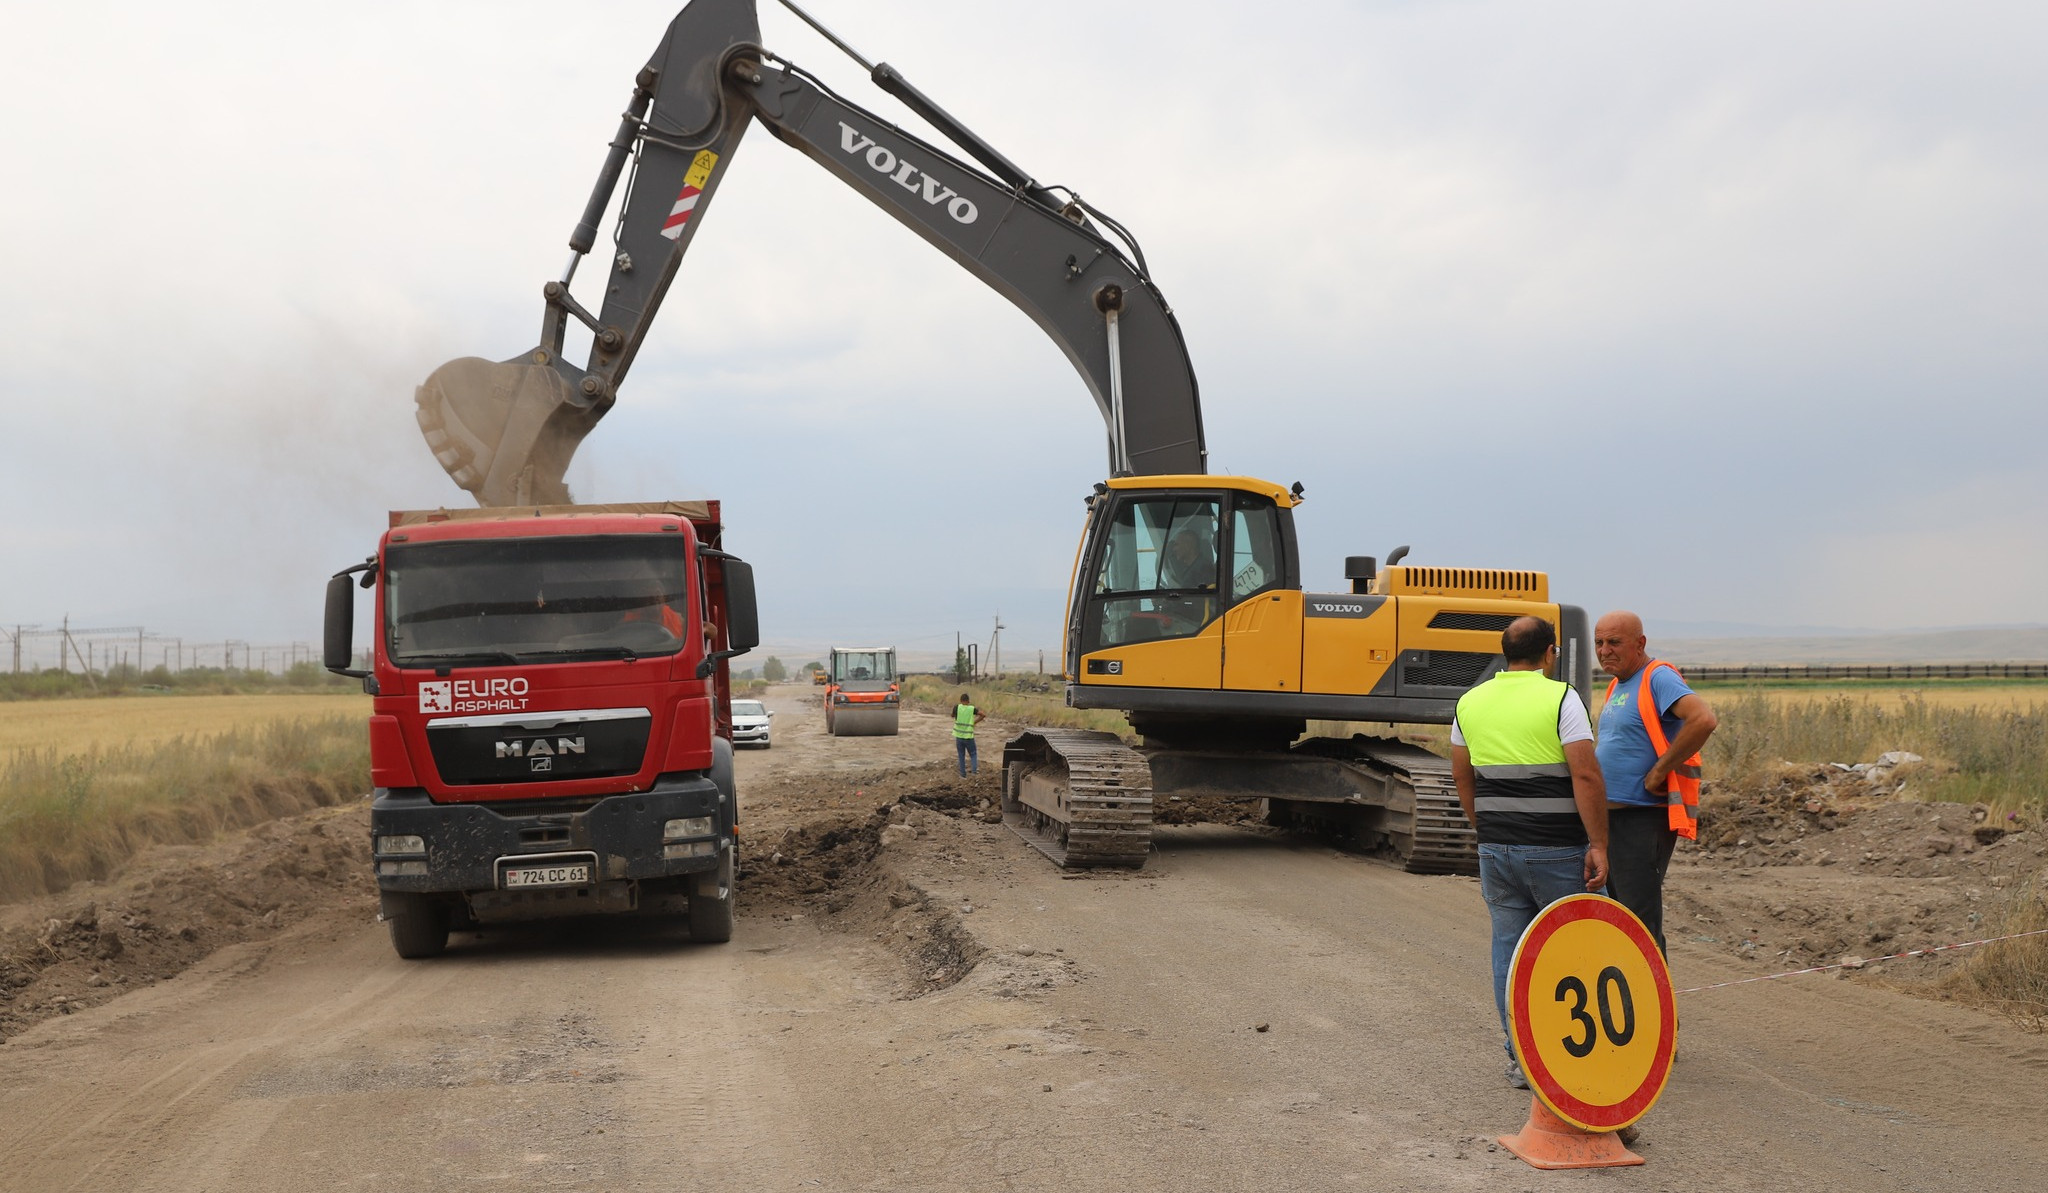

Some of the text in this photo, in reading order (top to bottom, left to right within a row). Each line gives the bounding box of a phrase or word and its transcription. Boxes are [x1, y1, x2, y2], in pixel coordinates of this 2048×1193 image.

[838, 120, 979, 225] VOLVO
[1234, 566, 1257, 588] 4779
[1312, 603, 1363, 613] VOLVO
[454, 677, 529, 698] EURO
[454, 699, 529, 713] ASPHALT
[495, 736, 586, 758] MAN
[523, 870, 545, 884] 724
[548, 869, 566, 882] CC
[569, 867, 585, 881] 61
[1554, 965, 1636, 1058] 30
